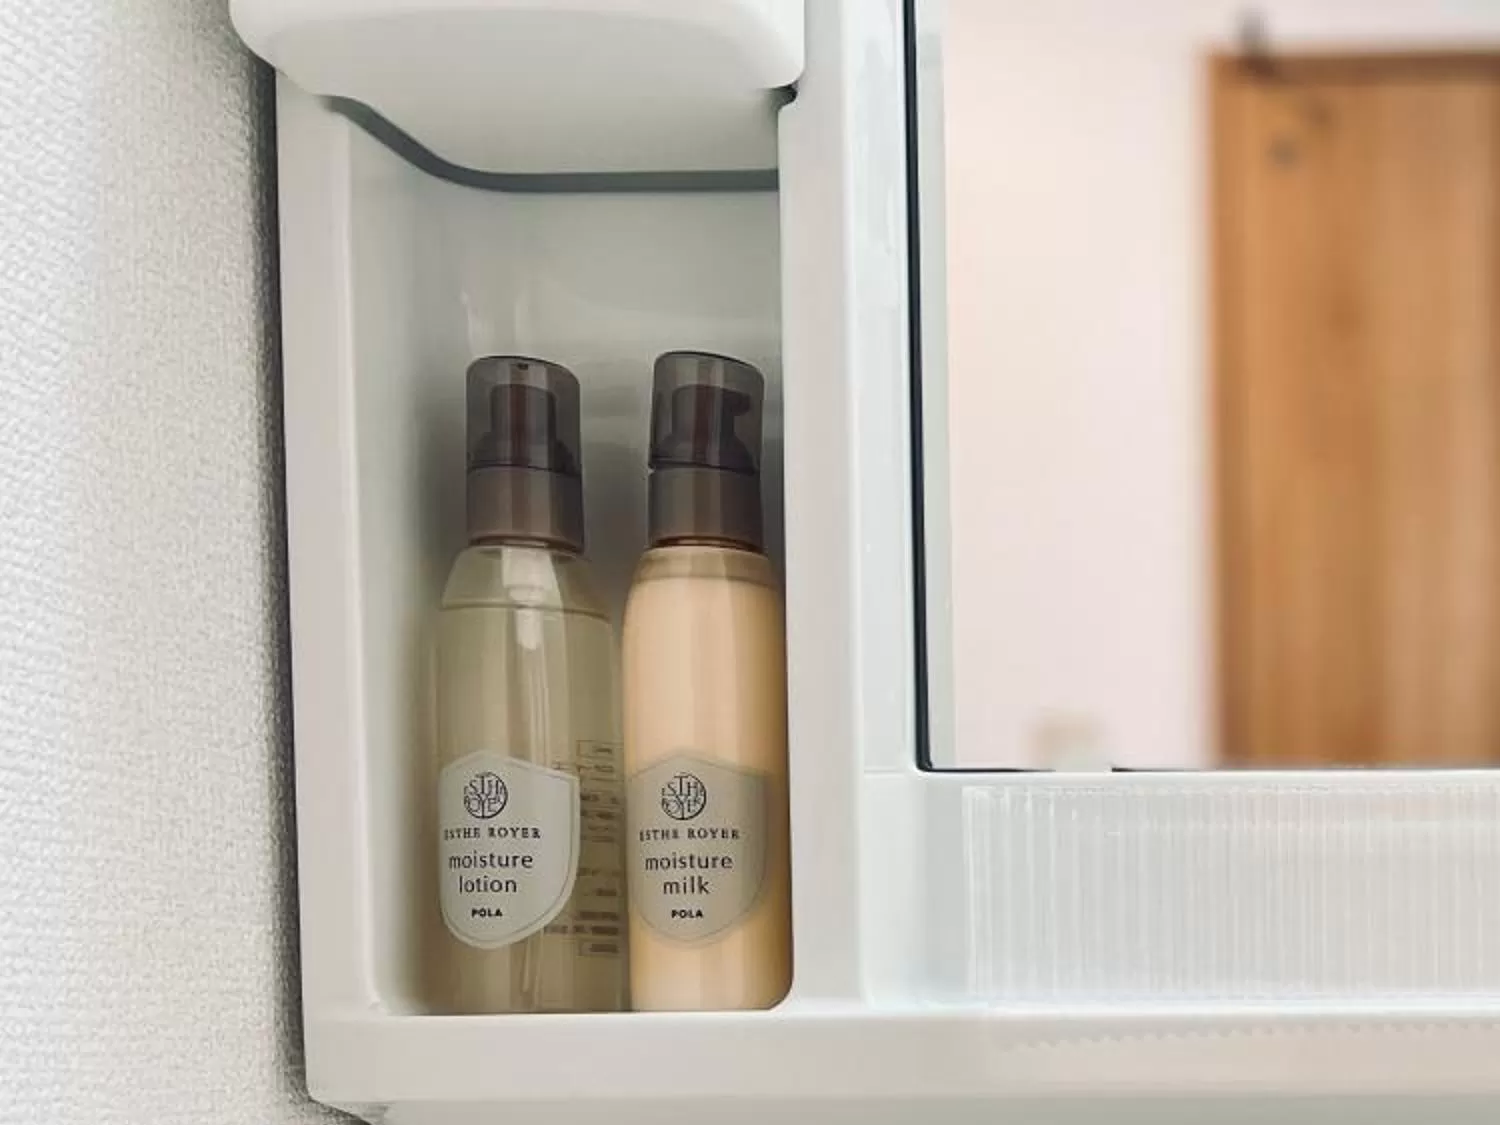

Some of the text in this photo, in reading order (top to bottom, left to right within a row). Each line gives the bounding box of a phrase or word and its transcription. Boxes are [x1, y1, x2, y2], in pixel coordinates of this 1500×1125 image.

[444, 827, 541, 841] ESTHE ROYER
[639, 827, 740, 842] ESTHE ROYER
[449, 850, 534, 869] moisture
[645, 851, 734, 871] moisture
[459, 875, 517, 894] lotion
[663, 875, 710, 895] milk
[471, 907, 503, 918] POLA
[671, 909, 704, 919] POLA
